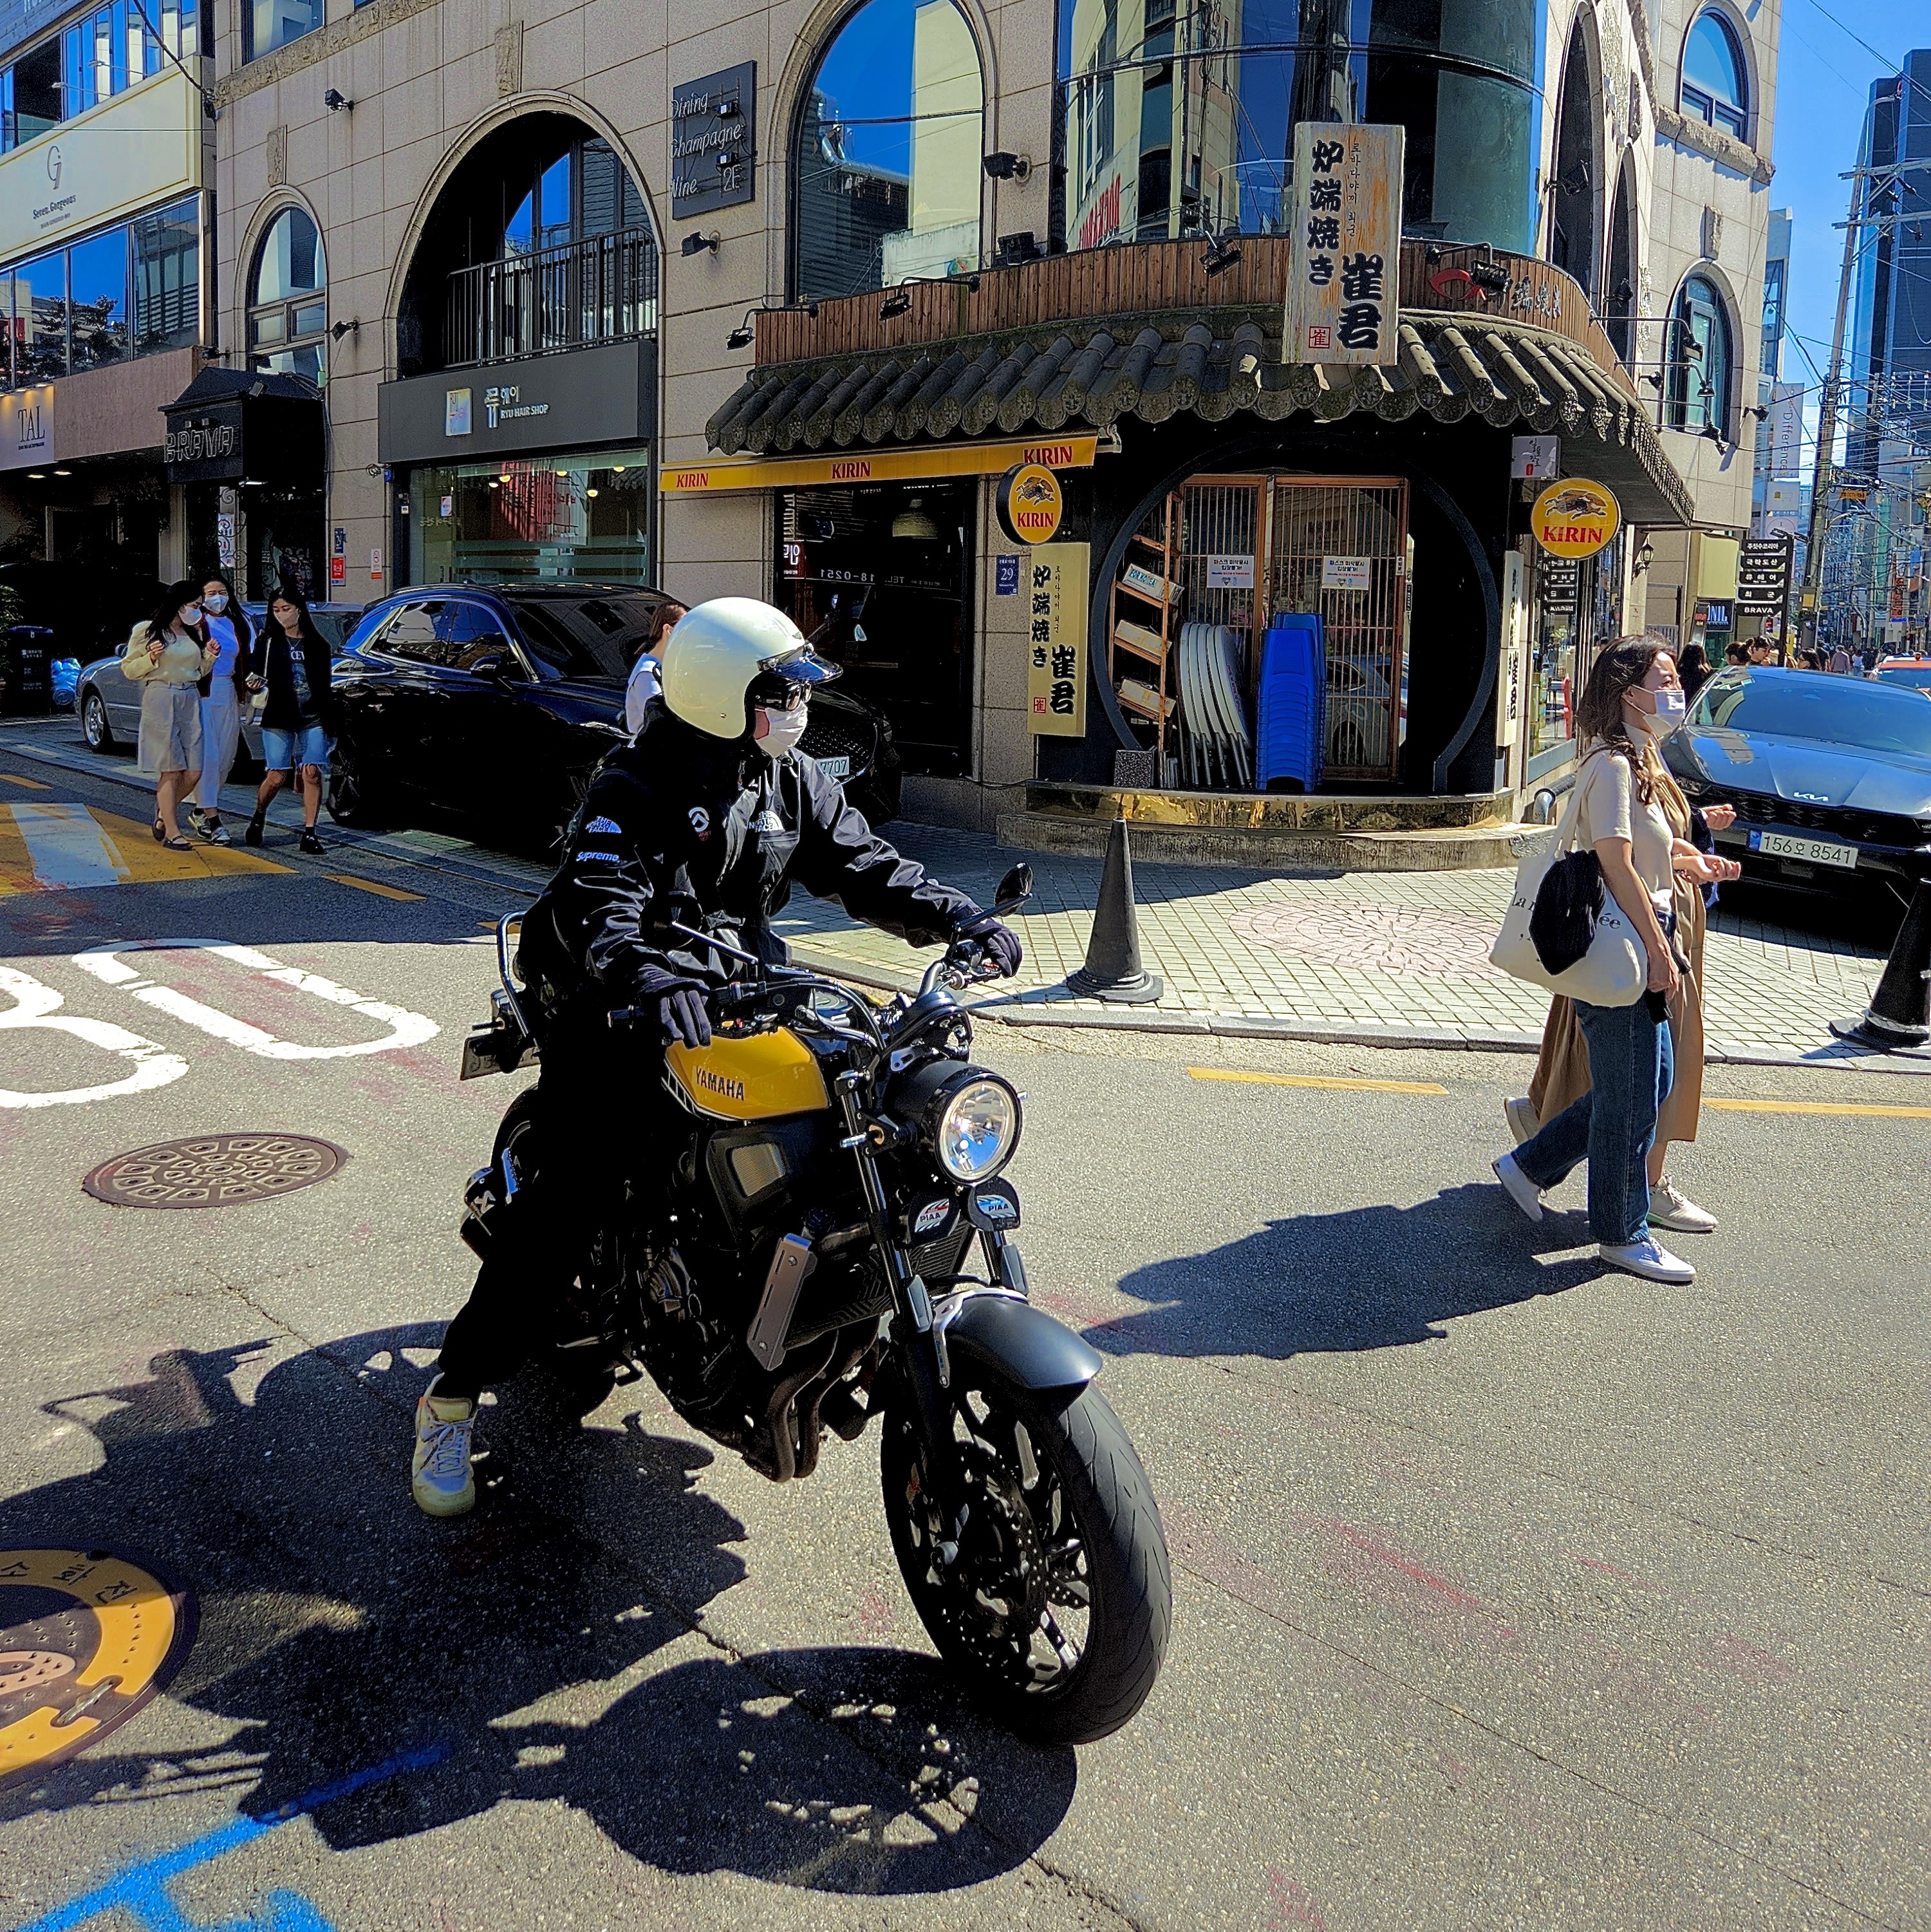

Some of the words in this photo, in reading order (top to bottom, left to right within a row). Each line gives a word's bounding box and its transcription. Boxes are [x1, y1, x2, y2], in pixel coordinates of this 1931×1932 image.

[671, 92, 709, 120] Dining
[670, 123, 742, 159] Champagne
[723, 164, 743, 191] 2F
[1347, 142, 1361, 205] 로바다야끼
[1307, 138, 1345, 286] 炉端焼き
[1336, 252, 1385, 351] 崔君
[18, 406, 45, 442] TAL
[500, 409, 514, 420] RYU
[514, 406, 530, 417] HAIR
[530, 404, 548, 415] SHOP
[164, 426, 234, 463] BRAVA
[1779, 412, 1794, 470] Difference
[1024, 445, 1073, 465] KIRIN
[676, 473, 709, 487] KIRIN
[832, 461, 871, 479] KIRIN
[1017, 512, 1054, 527] KIRIN
[1542, 525, 1603, 543] KIRIN
[1001, 568, 1013, 580] 29
[1031, 565, 1052, 668] 炉端焼き
[1049, 644, 1076, 715] 崔君
[820, 759, 847, 774] 7707
[596, 816, 612, 825] THE
[576, 851, 620, 863] Supreme
[1764, 836, 1805, 856] 156호
[1810, 844, 1851, 864] 8541
[696, 1065, 745, 1101] YAMAHA
[920, 1212, 941, 1223] PIAA
[988, 1203, 1009, 1212] PIAA
